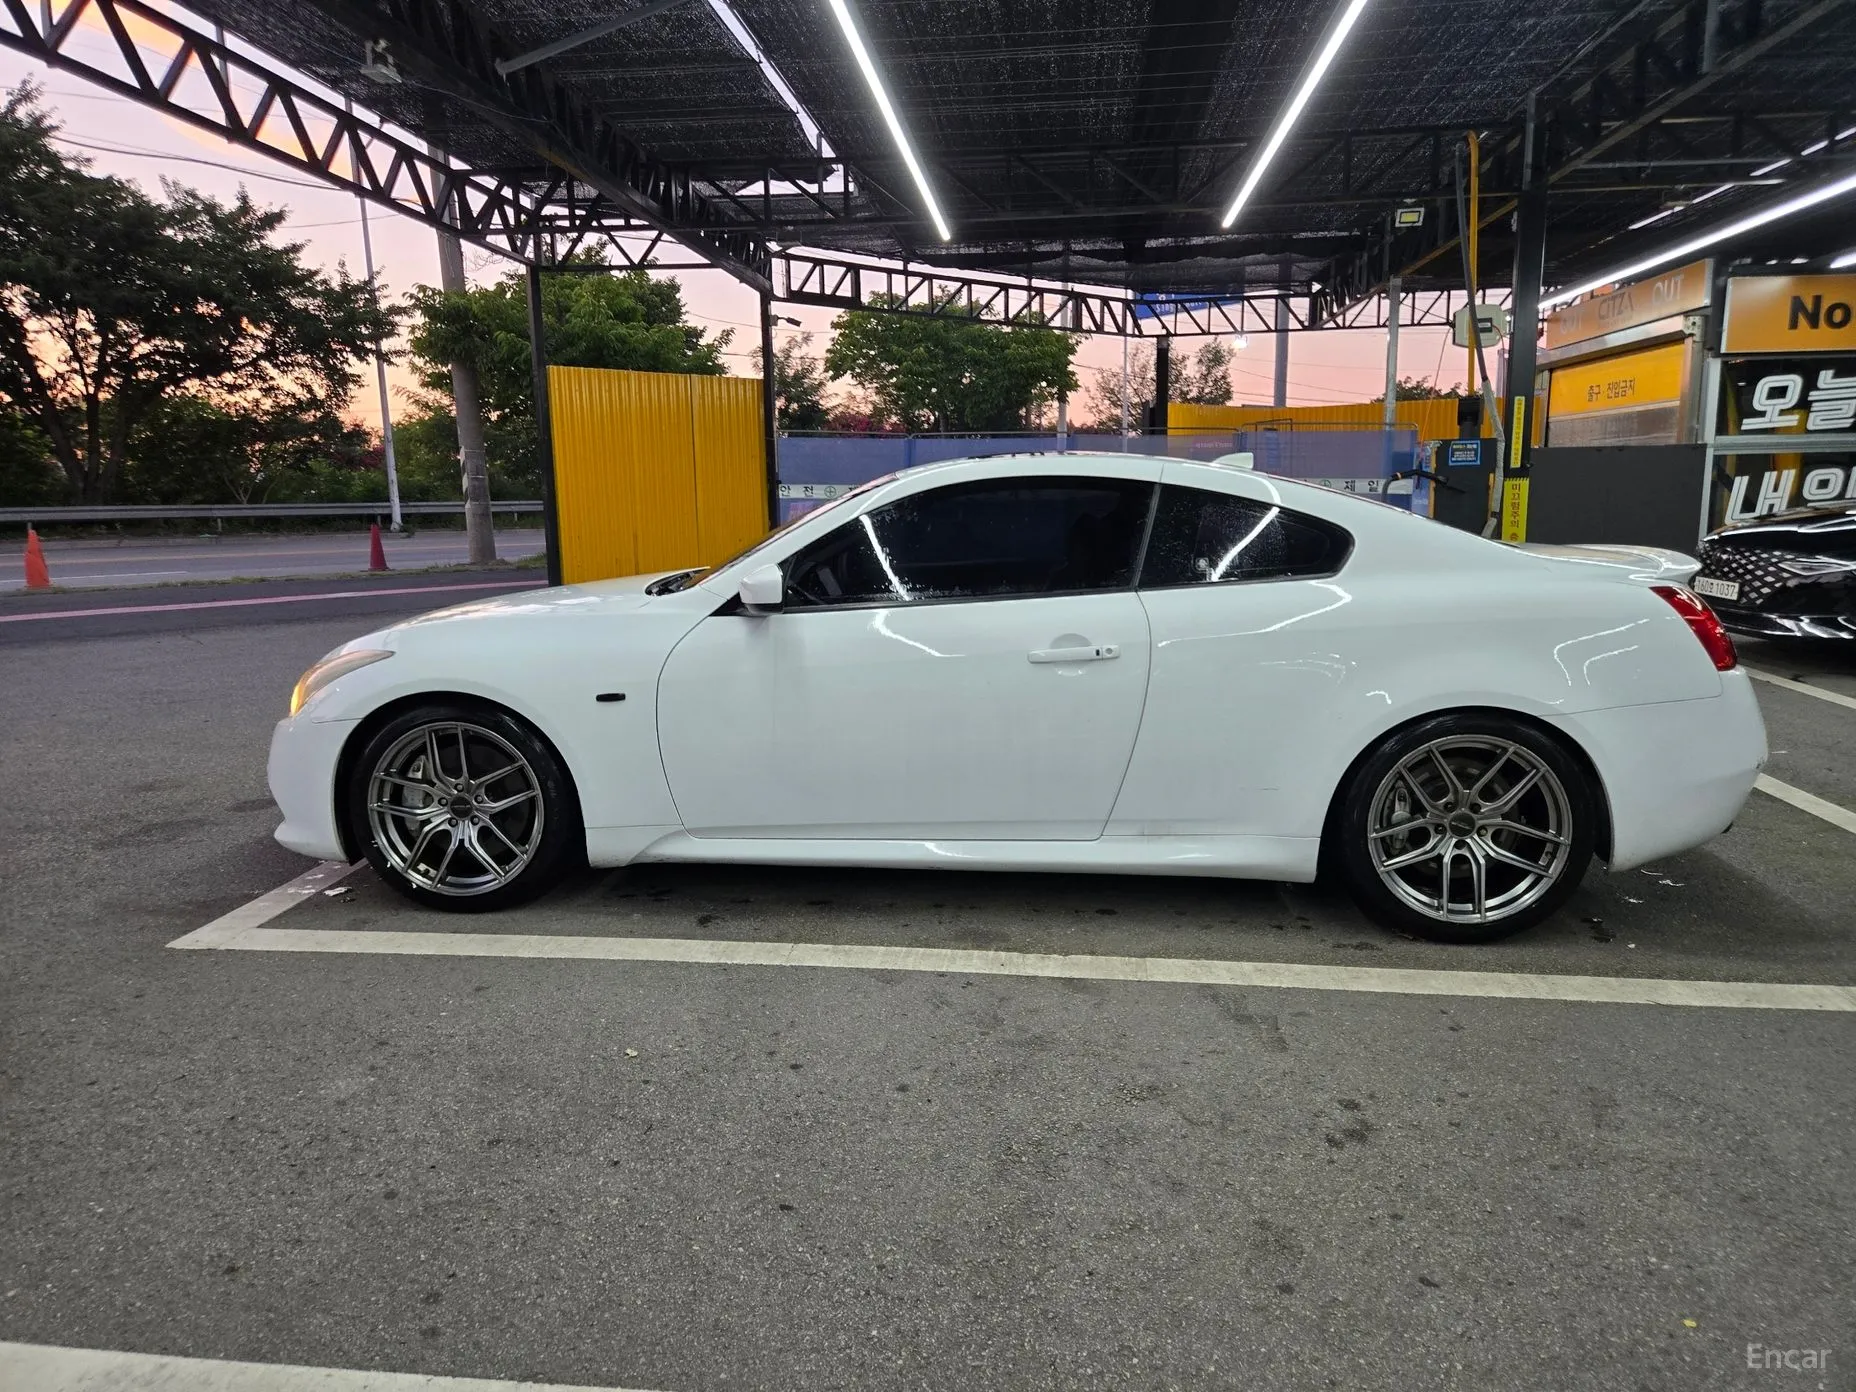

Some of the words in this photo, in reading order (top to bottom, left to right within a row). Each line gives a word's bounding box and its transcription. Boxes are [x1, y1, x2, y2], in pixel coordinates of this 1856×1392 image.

[1653, 275, 1684, 305] OUT
[1606, 377, 1636, 400] 진입금지
[1741, 369, 1856, 431] 오늘
[1715, 582, 1736, 598] 1037
